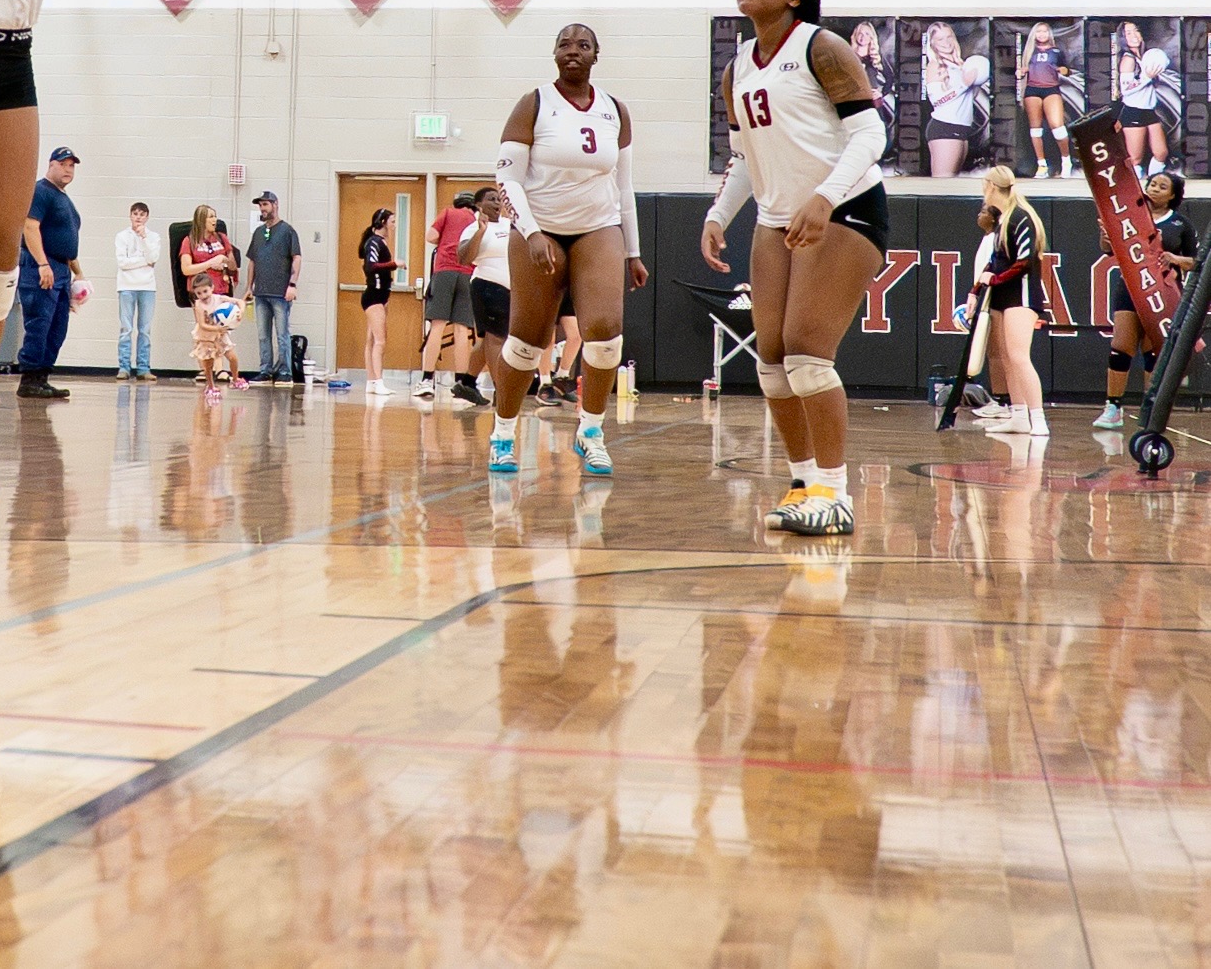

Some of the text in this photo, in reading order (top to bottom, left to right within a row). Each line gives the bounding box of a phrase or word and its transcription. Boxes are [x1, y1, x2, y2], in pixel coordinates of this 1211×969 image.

[1036, 53, 1048, 62] 13
[742, 88, 772, 129] 13
[899, 20, 921, 173] ROBERTS
[1185, 20, 1209, 175] MOTES
[421, 117, 442, 134] EXIT
[580, 127, 597, 154] 3
